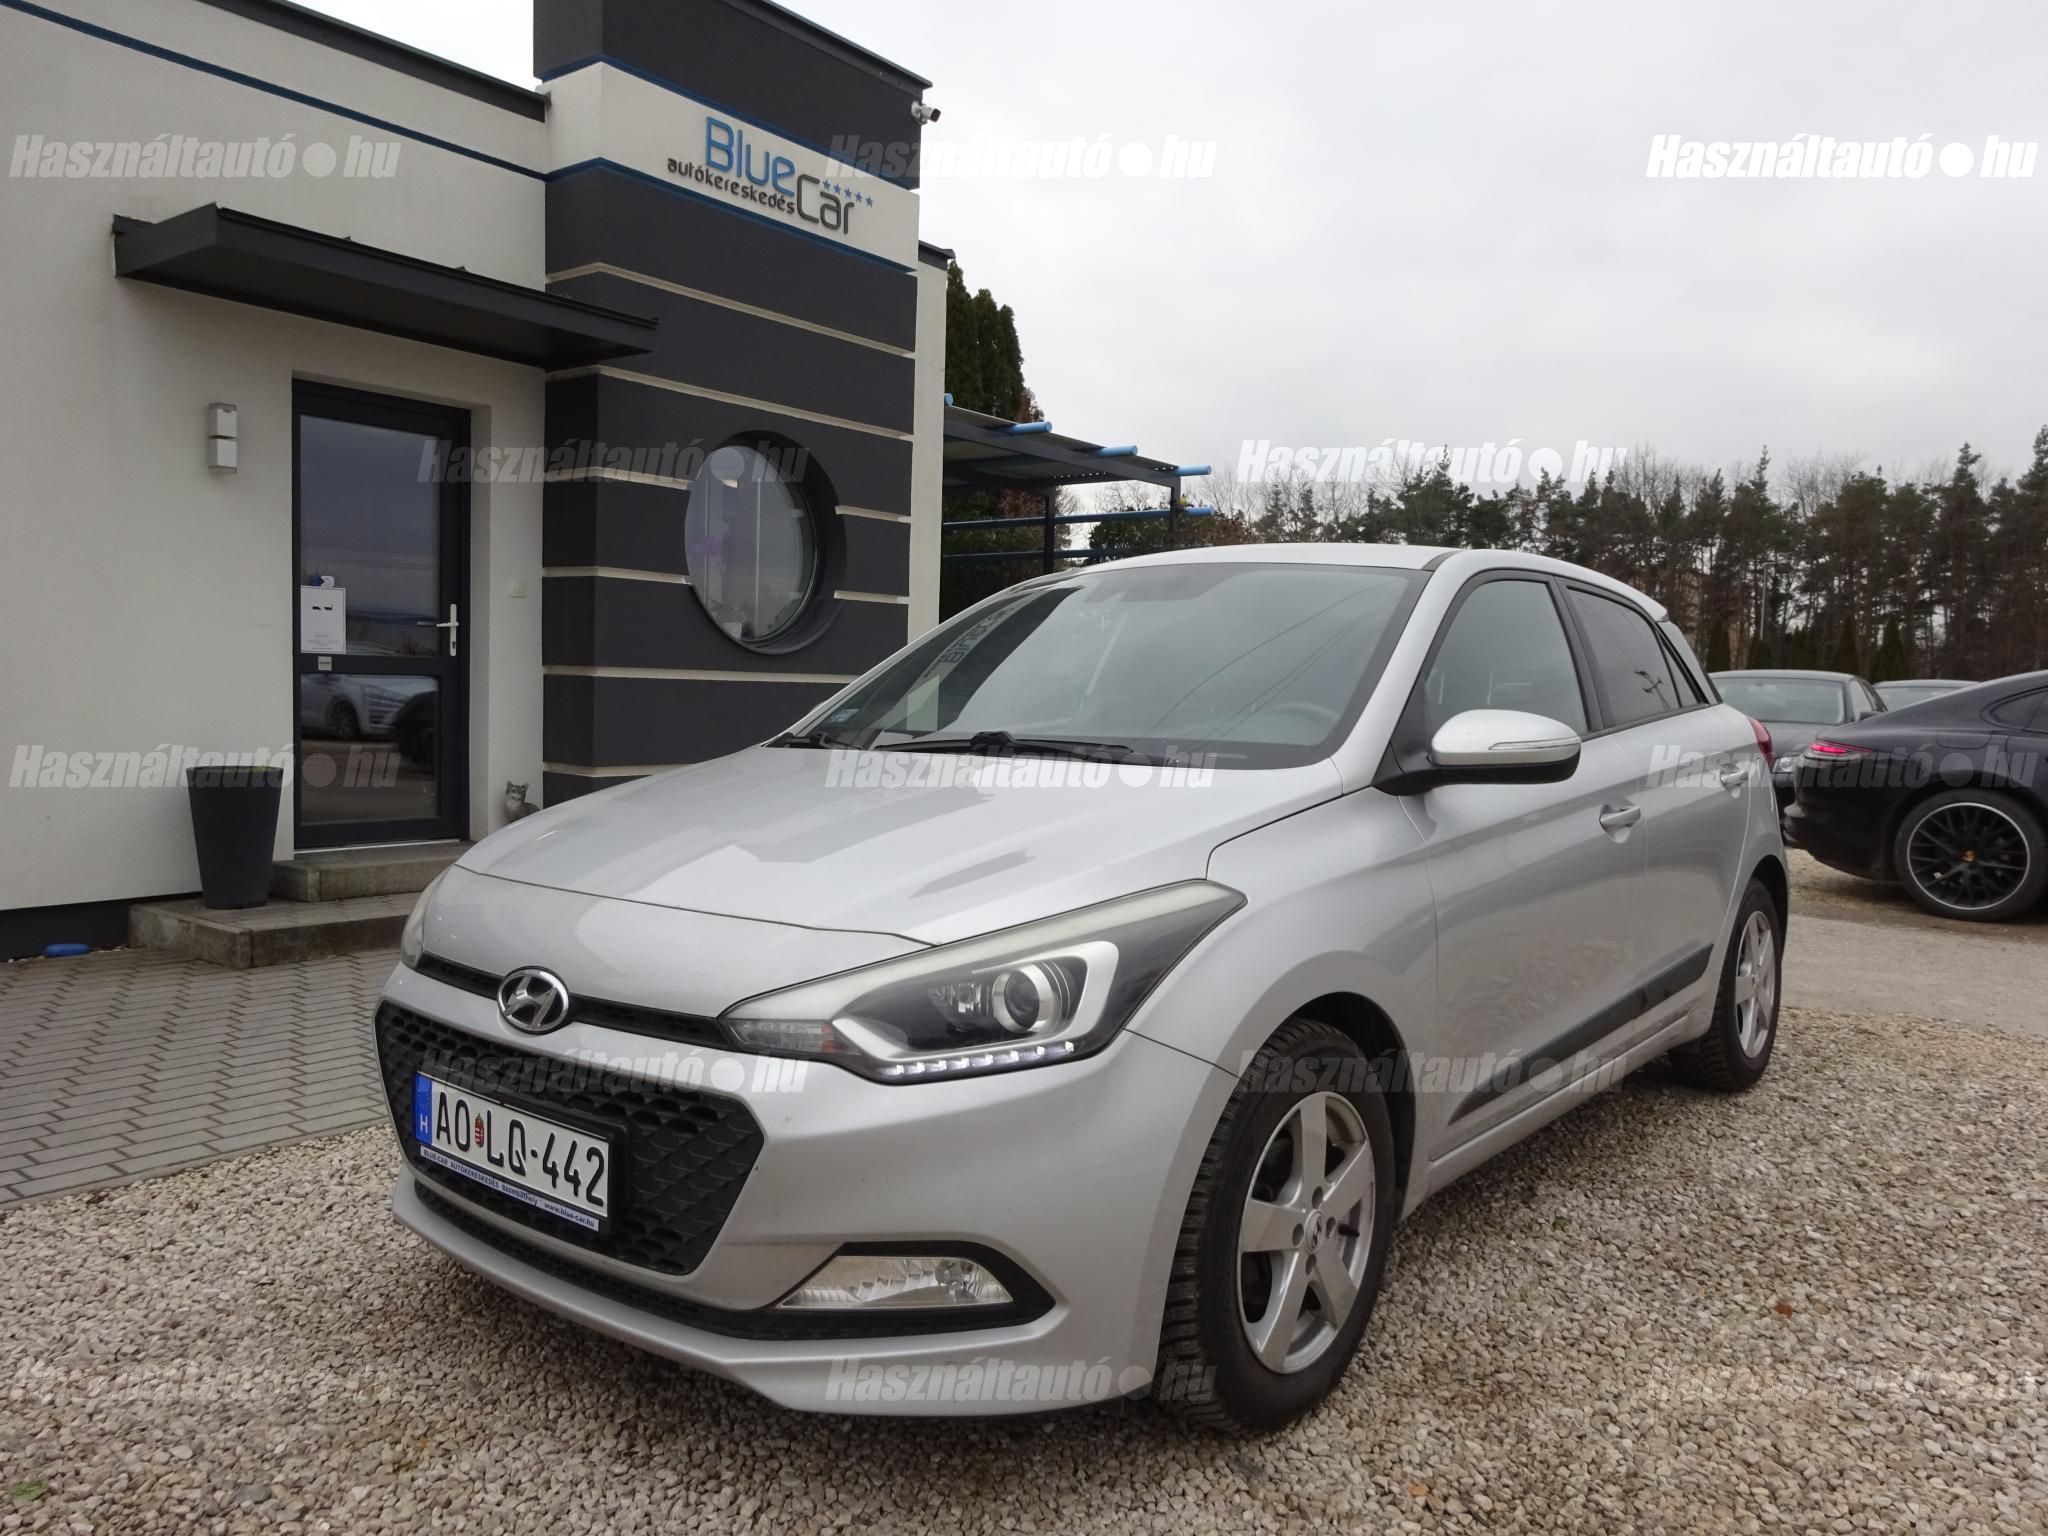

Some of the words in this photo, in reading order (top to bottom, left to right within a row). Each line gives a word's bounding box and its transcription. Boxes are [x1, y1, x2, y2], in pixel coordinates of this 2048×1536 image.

[667, 158, 795, 215] autókereskedés
[419, 1113, 428, 1134] H
[436, 1091, 471, 1152] AO
